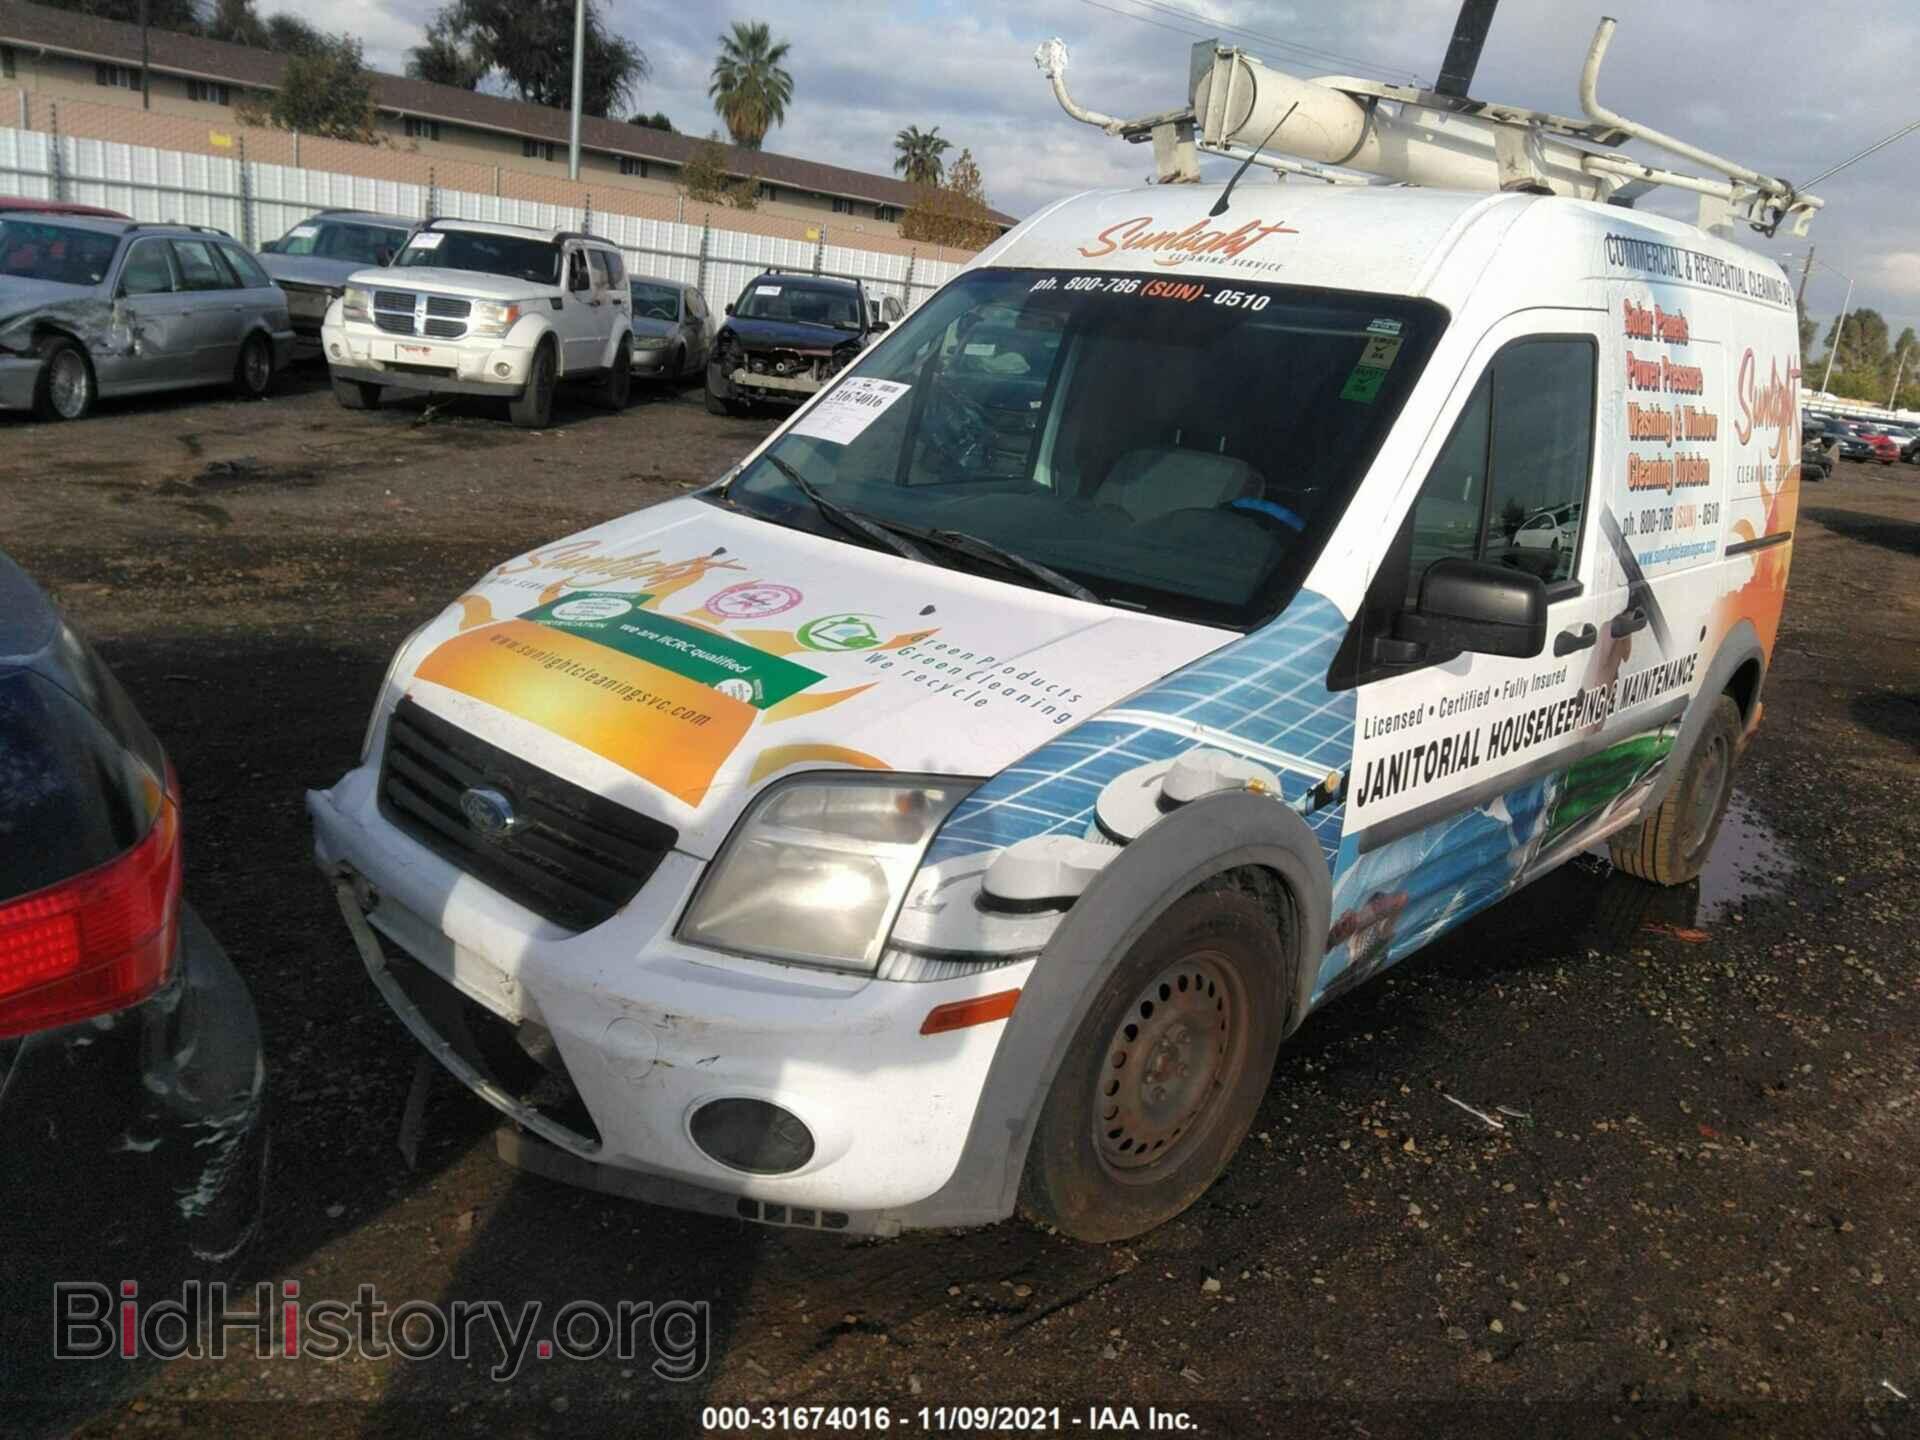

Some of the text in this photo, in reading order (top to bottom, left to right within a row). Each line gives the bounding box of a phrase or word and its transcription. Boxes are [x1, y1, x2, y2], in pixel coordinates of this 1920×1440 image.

[1077, 216, 1300, 267] Sunlight
[1167, 252, 1284, 273] CLEANING SERVICE
[1604, 232, 1684, 280] COMMERCIAL
[1685, 250, 1693, 281] &
[1694, 253, 1748, 295] RESIDENTIAL
[1030, 276, 1057, 293] ph.
[1064, 275, 1141, 294] 800-786
[1141, 278, 1204, 303] (SUN)
[1213, 291, 1271, 312] 0510
[1627, 350, 1661, 393] Power
[1627, 401, 1673, 448] Washing
[1627, 451, 1711, 496] Cleaning Division
[488, 633, 713, 728] www.sunlightcleaningsvc.com
[690, 647, 752, 674] qualified
[865, 651, 989, 709] We recycle
[897, 646, 1074, 726] Green Cleaning
[911, 632, 1083, 705] Green Products
[1363, 665, 1568, 741] Licensed Certified Fully Insured
[1357, 729, 1481, 809] JANITORIAL
[1486, 683, 1607, 762] HOUSEKEEPING
[1618, 652, 1700, 711] MAINTENANCE
